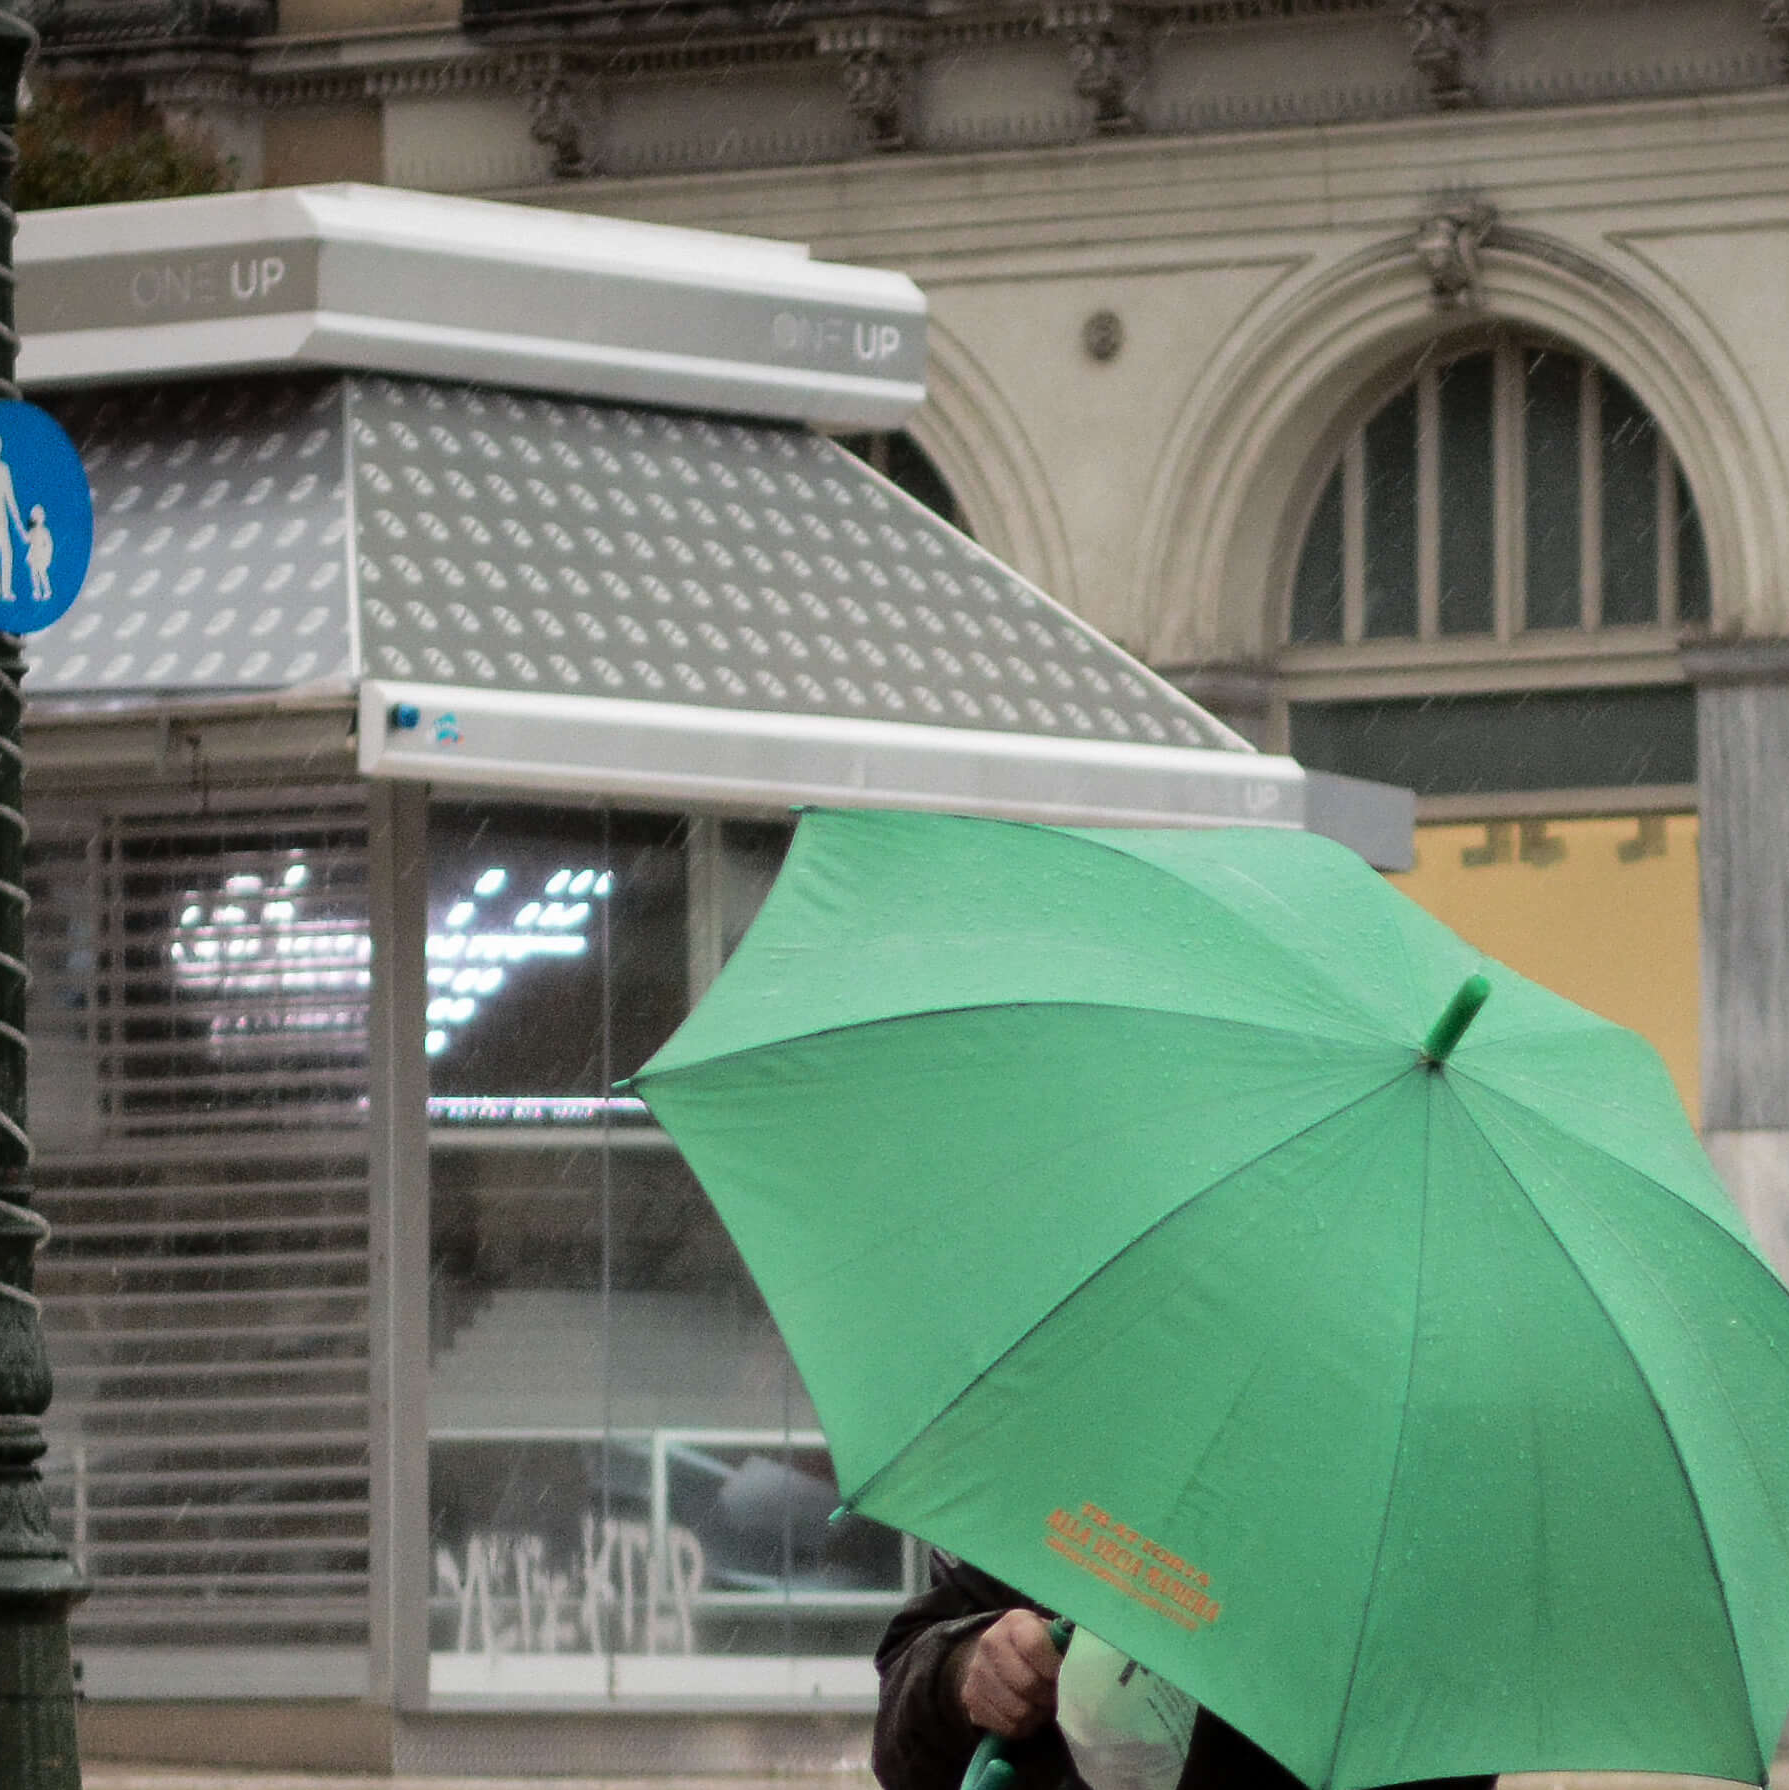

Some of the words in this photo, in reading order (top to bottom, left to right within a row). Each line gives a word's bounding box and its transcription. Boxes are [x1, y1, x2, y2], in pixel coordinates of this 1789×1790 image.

[229, 257, 286, 300] UP
[855, 320, 900, 361] UP
[1045, 1507, 1093, 1548] ALLA
[1081, 1500, 1211, 1588] TRATTORIA
